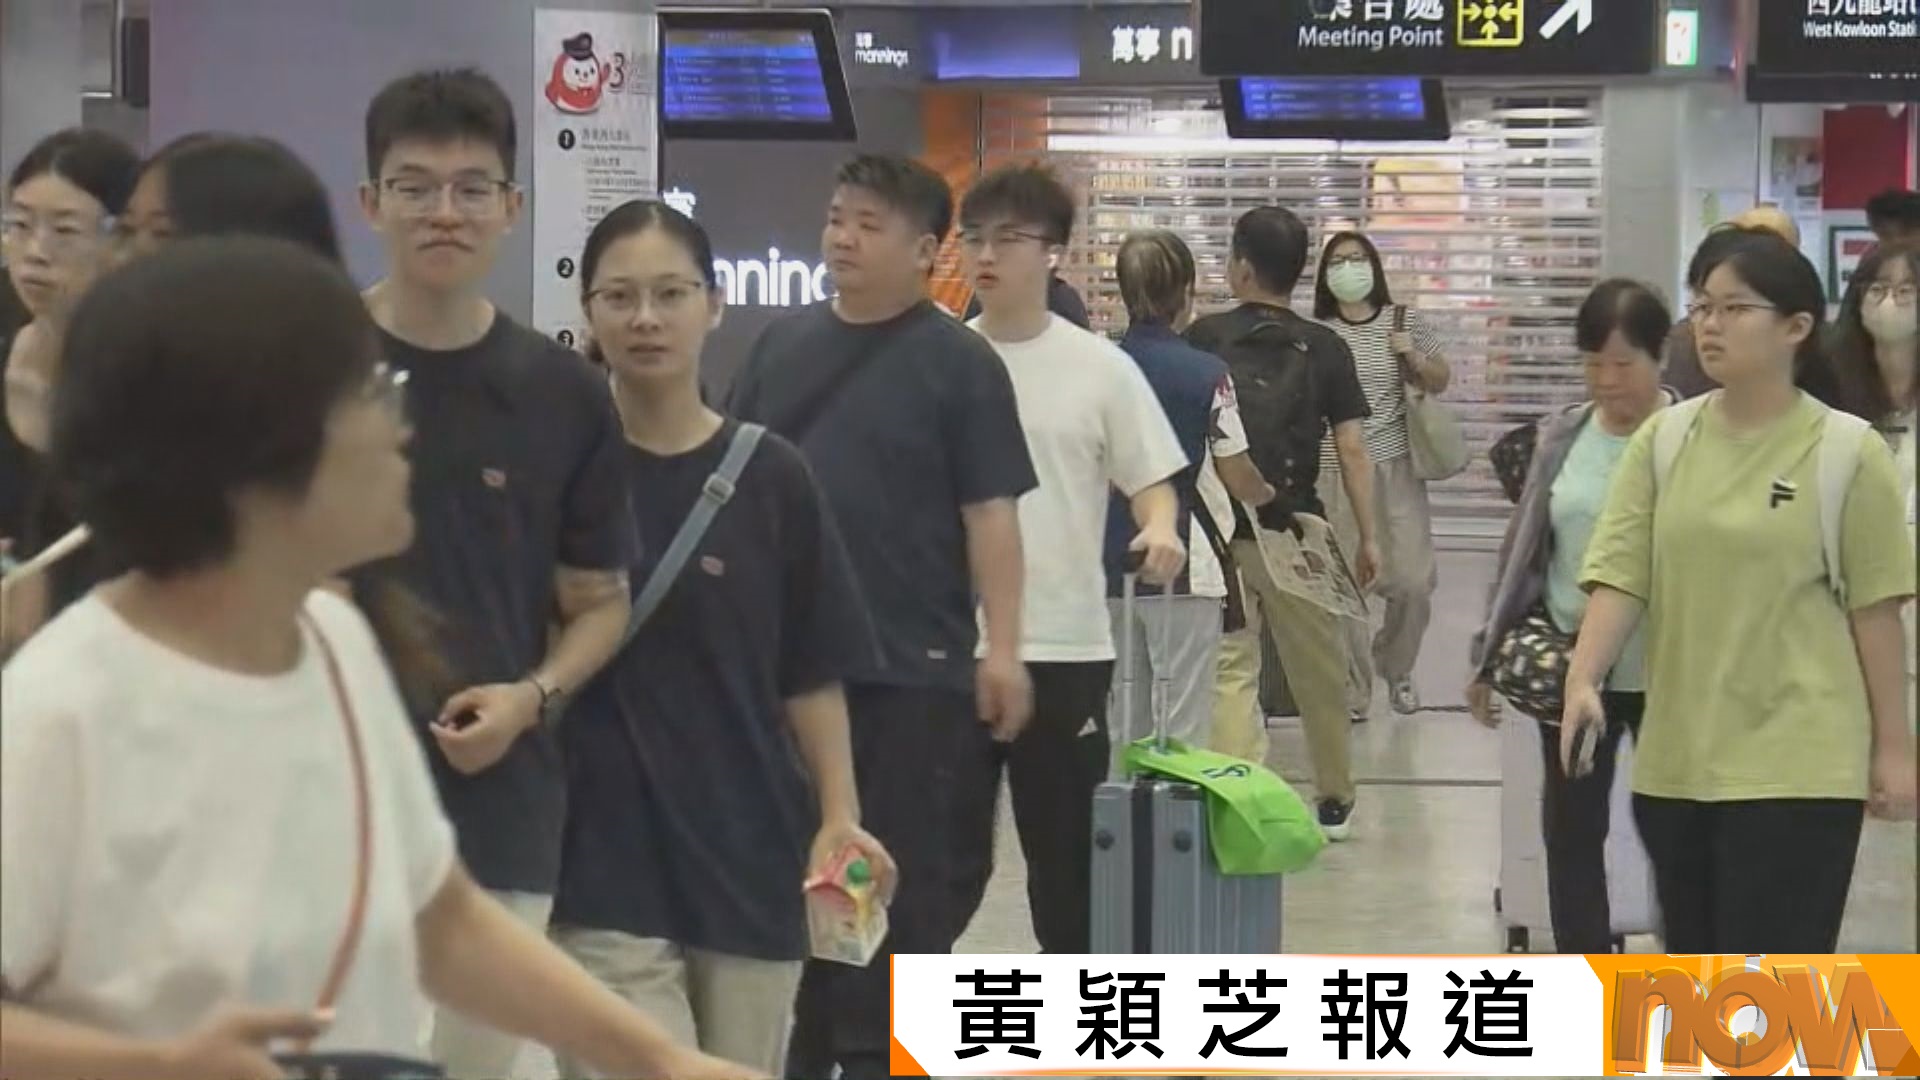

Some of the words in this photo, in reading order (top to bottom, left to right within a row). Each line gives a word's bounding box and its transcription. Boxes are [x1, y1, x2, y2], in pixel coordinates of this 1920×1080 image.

[1298, 25, 1384, 52] Meeting
[1388, 25, 1444, 48] Point
[1803, 20, 1832, 38] West
[1833, 20, 1887, 38] Kowloon
[855, 46, 909, 68] mannings
